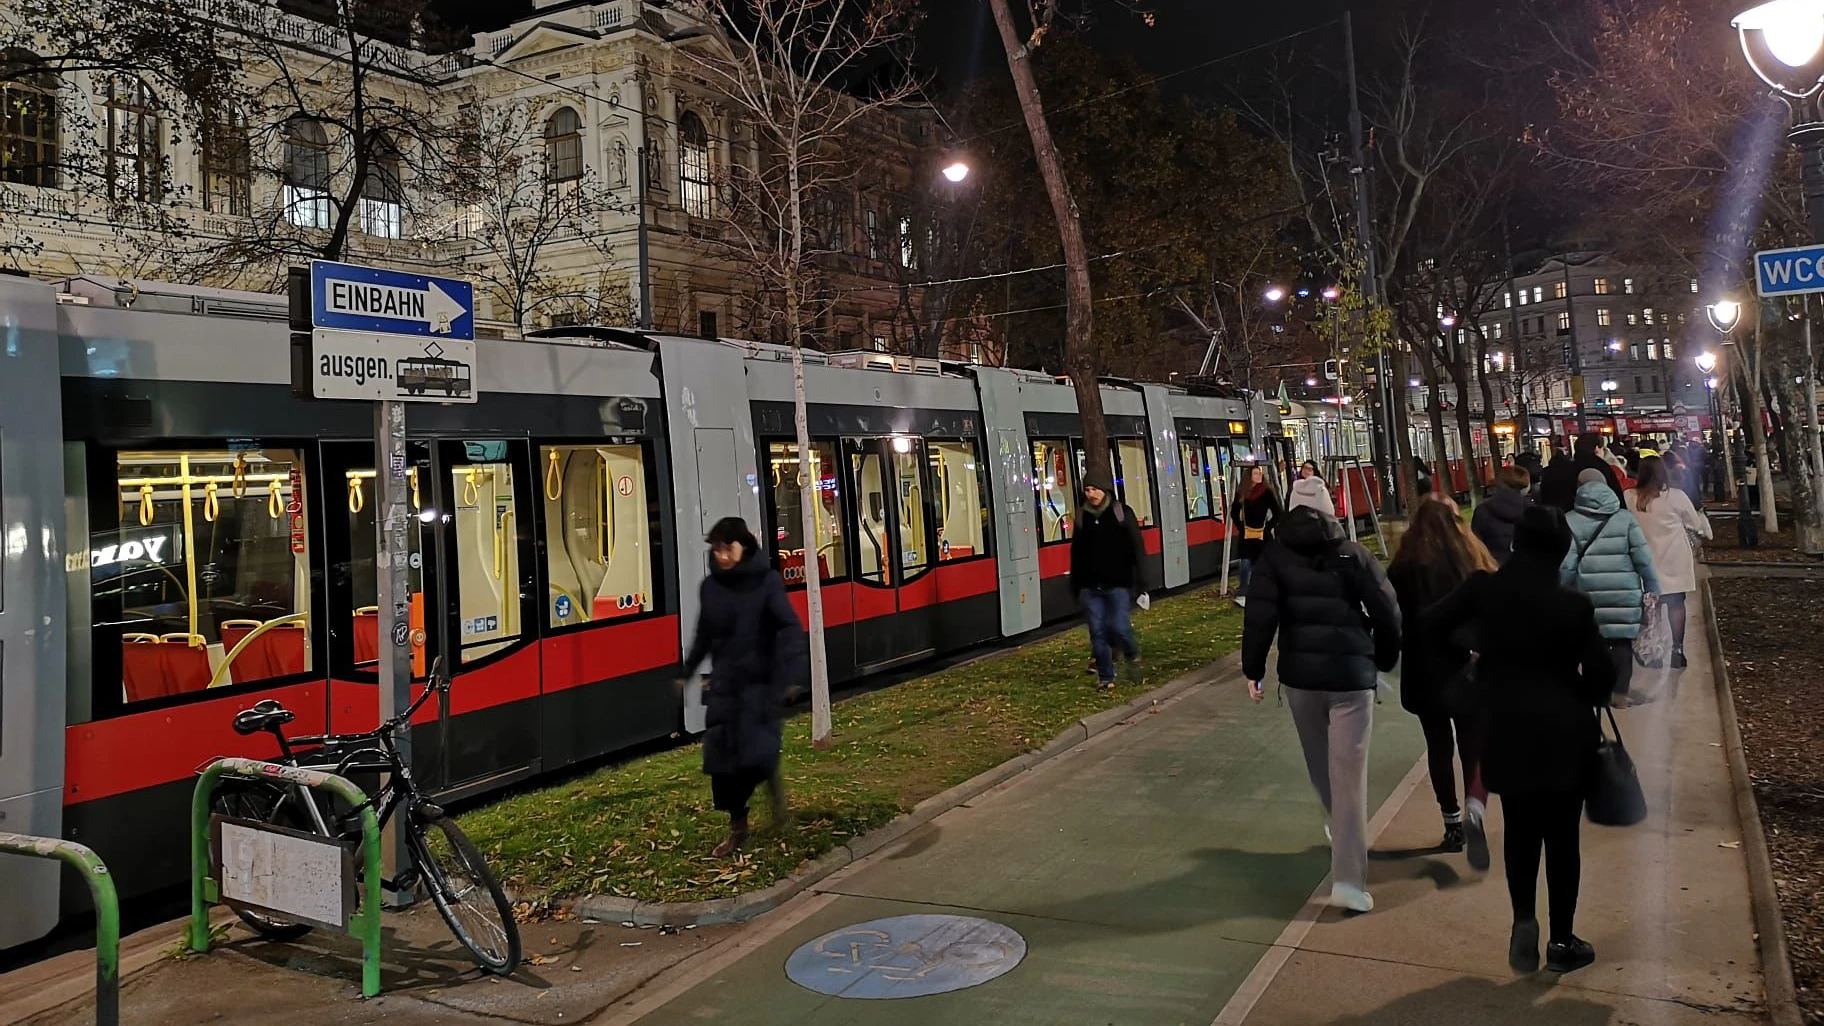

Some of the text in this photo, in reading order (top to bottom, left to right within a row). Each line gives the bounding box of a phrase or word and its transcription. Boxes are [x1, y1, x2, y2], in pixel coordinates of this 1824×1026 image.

[1763, 257, 1814, 285] WC
[332, 283, 425, 318] EINBAHN
[320, 354, 393, 386] ausgen.
